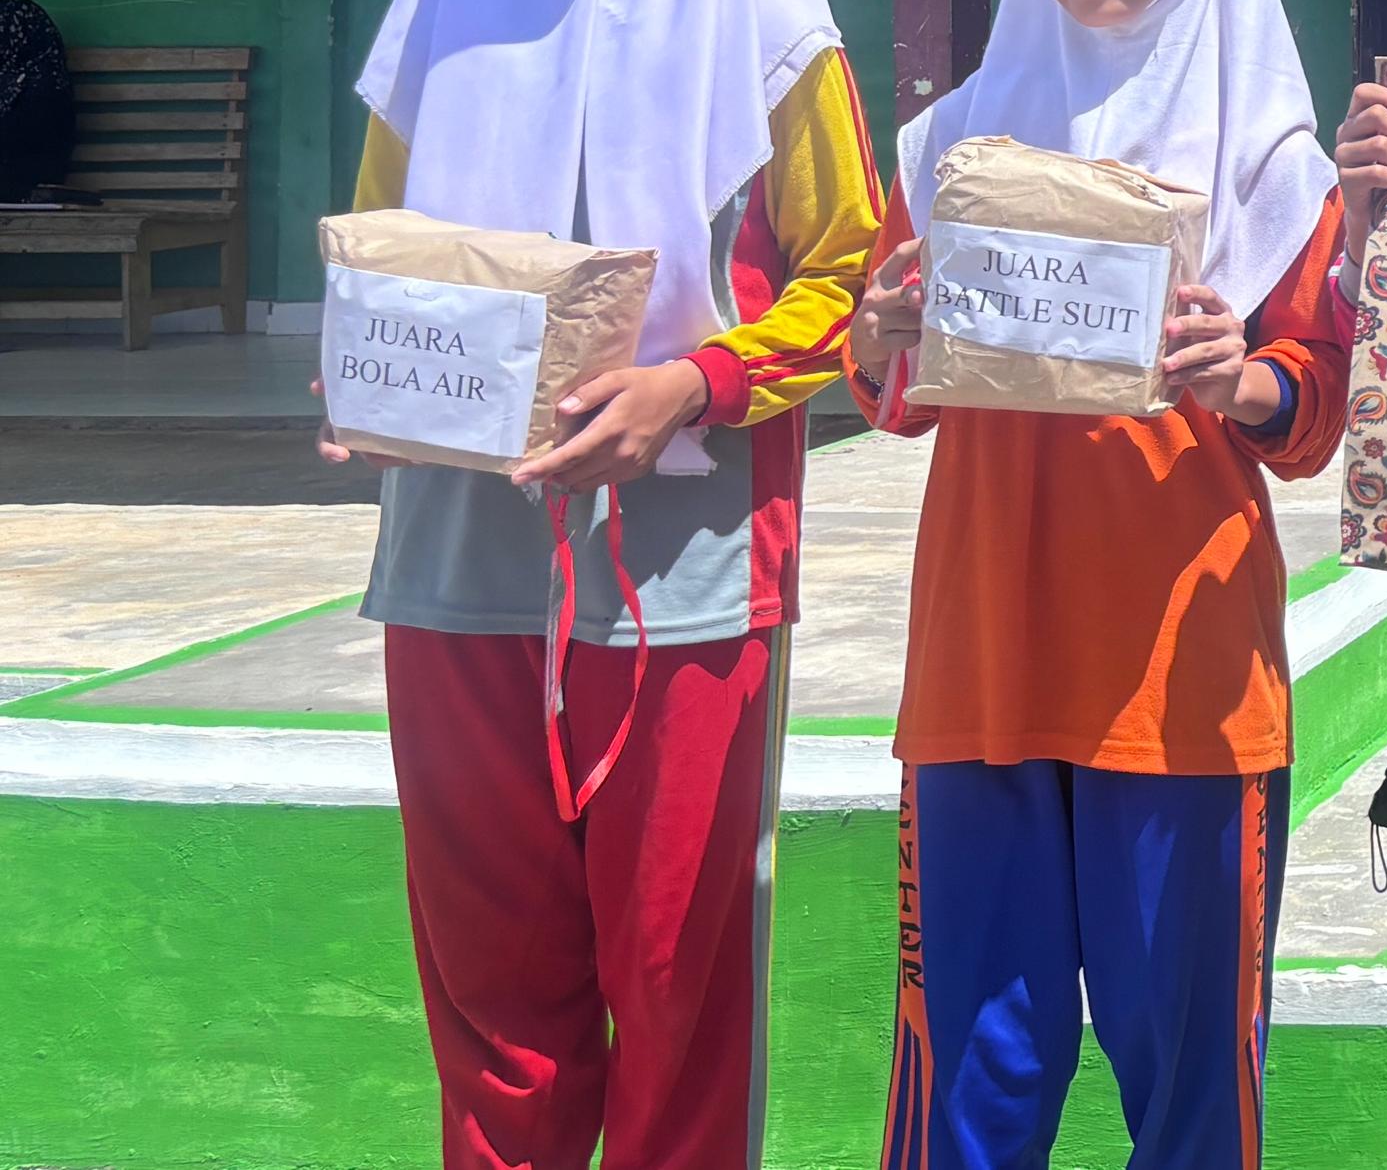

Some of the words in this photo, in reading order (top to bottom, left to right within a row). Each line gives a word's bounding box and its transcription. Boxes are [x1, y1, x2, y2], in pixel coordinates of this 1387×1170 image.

[983, 249, 1089, 285] JUARA
[935, 283, 1052, 323] BATTLE
[1062, 300, 1140, 333] SUIT
[365, 317, 466, 357] JUARA
[341, 355, 422, 391] BOLA
[432, 374, 486, 402] AIR
